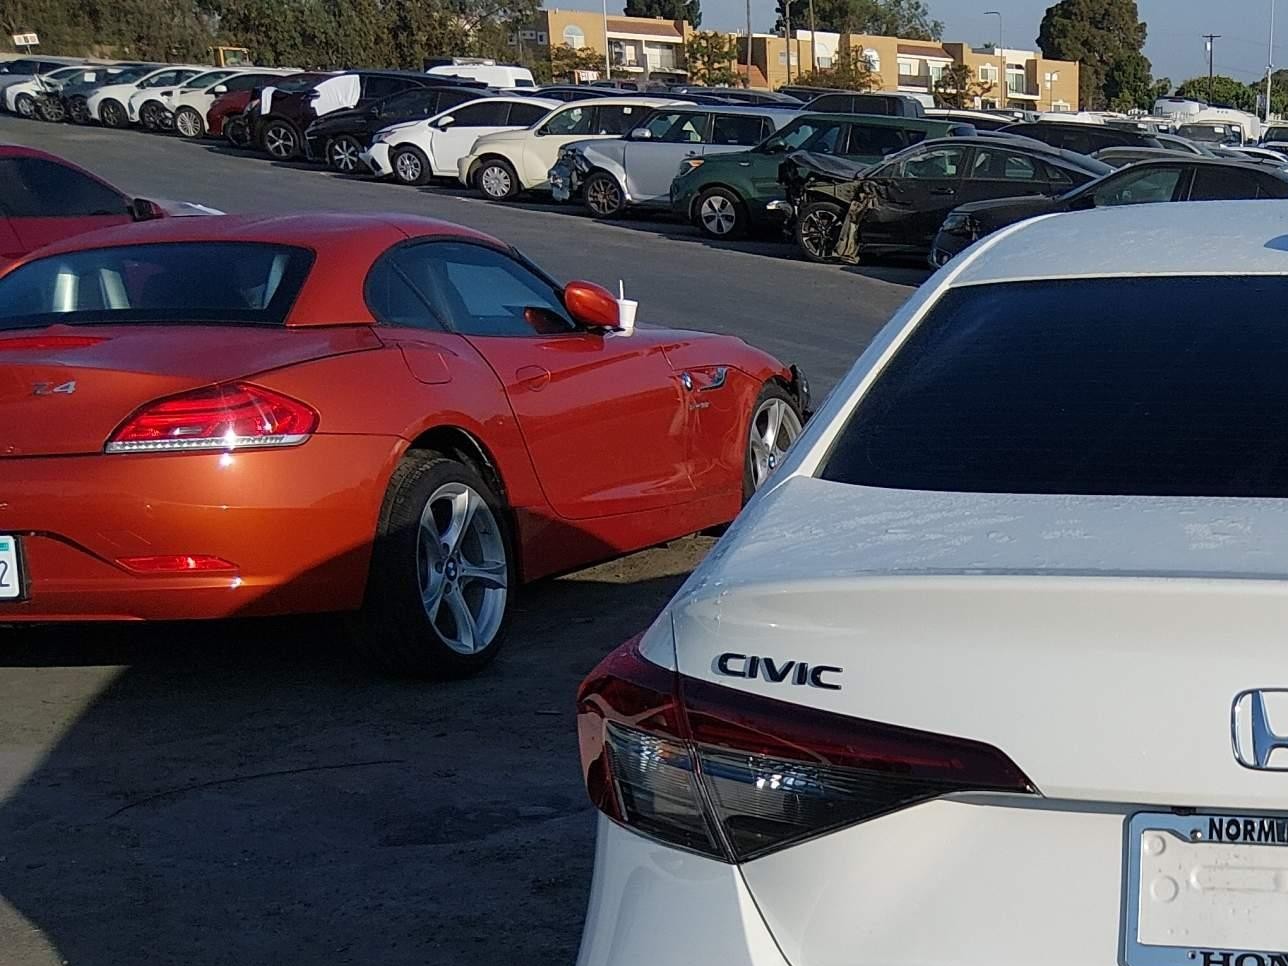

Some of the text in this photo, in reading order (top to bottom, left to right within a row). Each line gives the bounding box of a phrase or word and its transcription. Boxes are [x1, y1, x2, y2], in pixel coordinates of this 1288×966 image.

[33, 381, 76, 396] Z4
[715, 652, 844, 691] CIVIC
[1207, 816, 1277, 842] NORM
